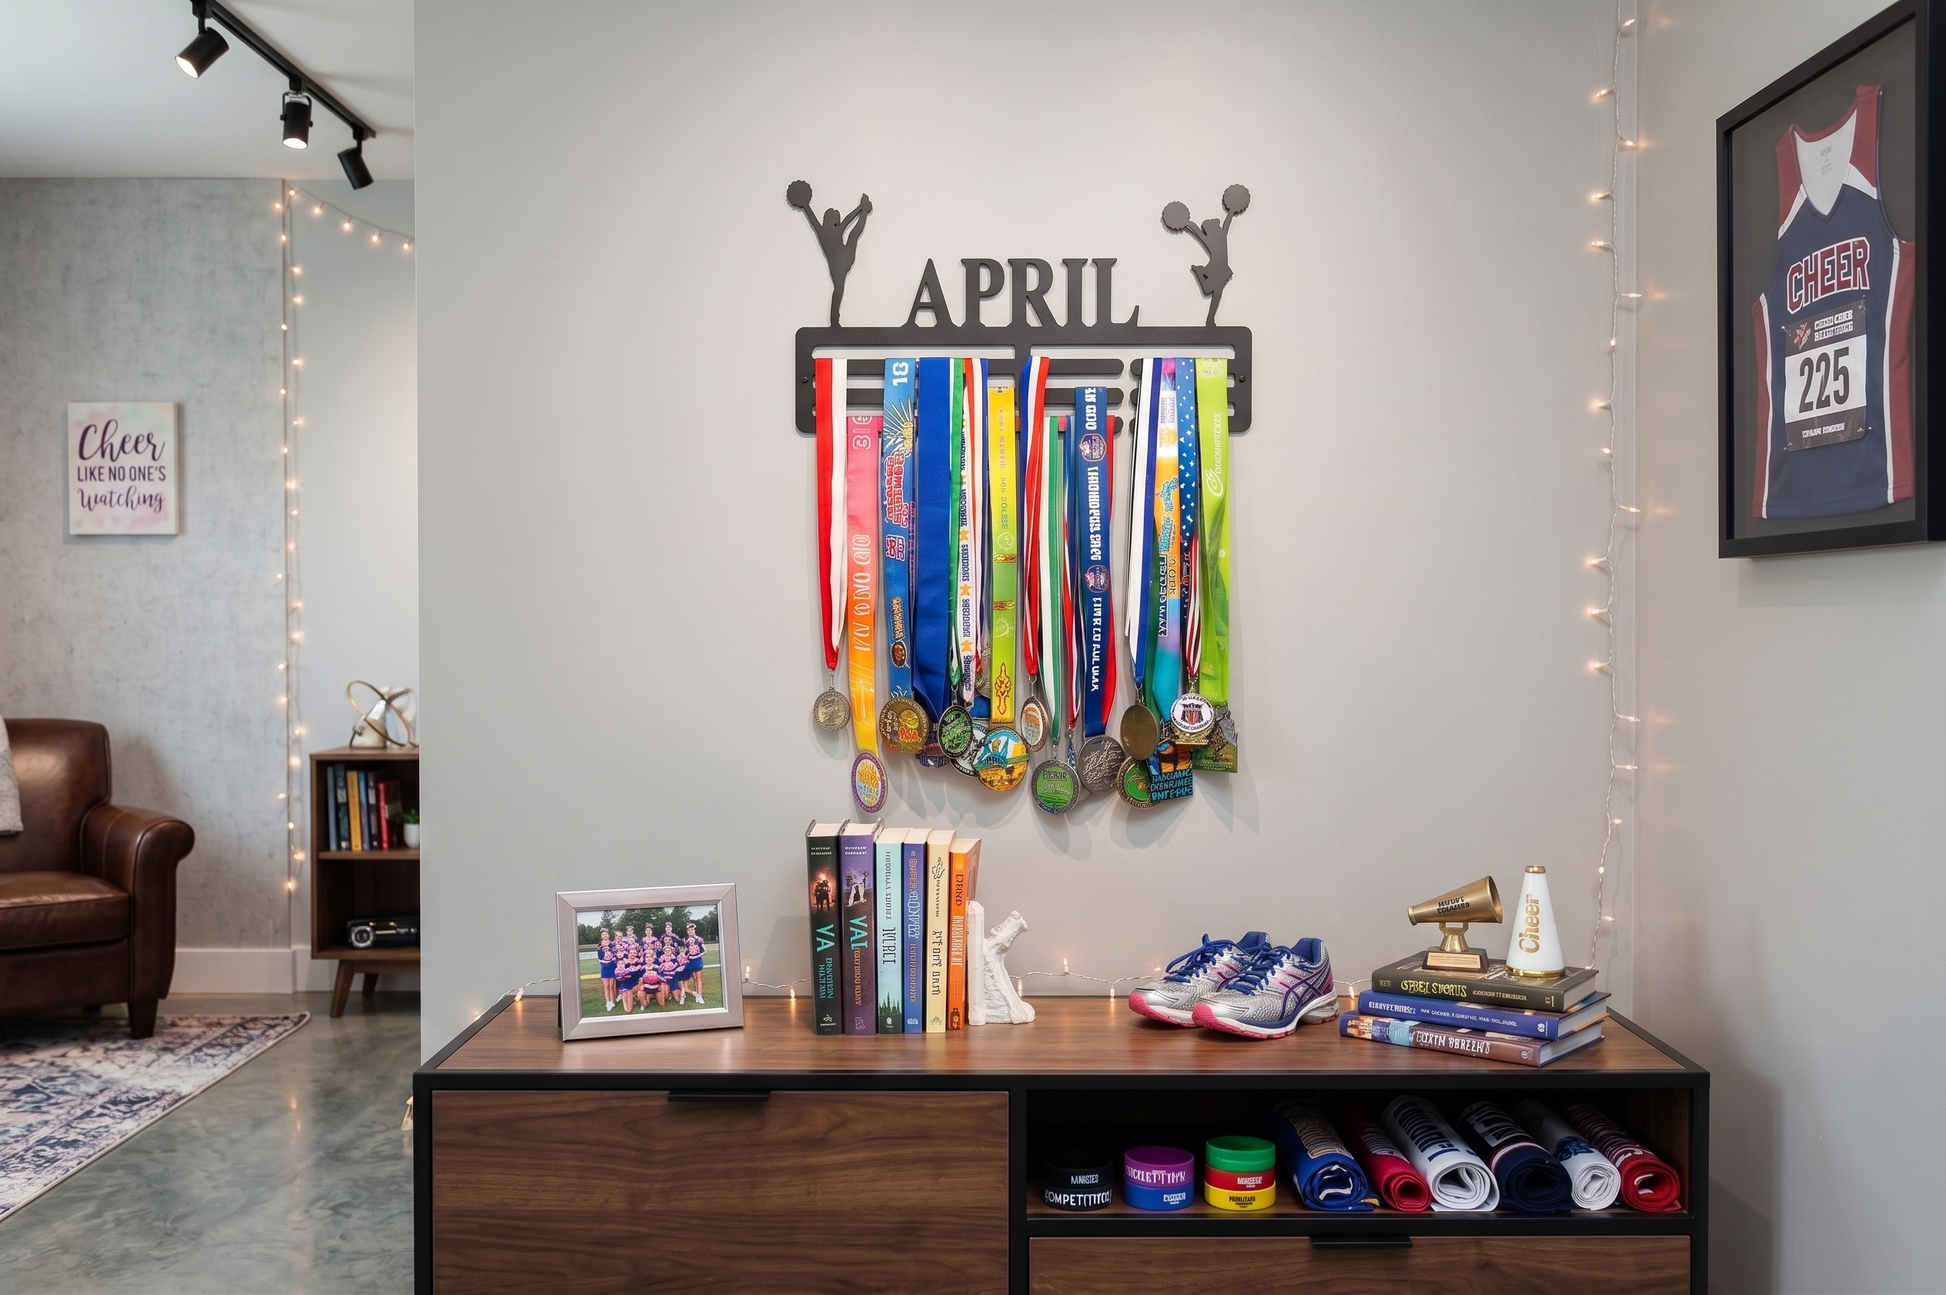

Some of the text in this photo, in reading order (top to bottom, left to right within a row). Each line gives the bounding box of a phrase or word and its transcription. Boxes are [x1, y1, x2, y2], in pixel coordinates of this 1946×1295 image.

[900, 258, 1140, 327] APRIL
[1787, 236, 1870, 314] CHEER
[1799, 346, 1850, 414] 225
[79, 419, 166, 462] Cheer
[77, 465, 167, 482] LIKE NO ONE'S
[77, 485, 165, 514] Watching
[816, 923, 835, 952] VA
[1519, 893, 1540, 953] Cheer
